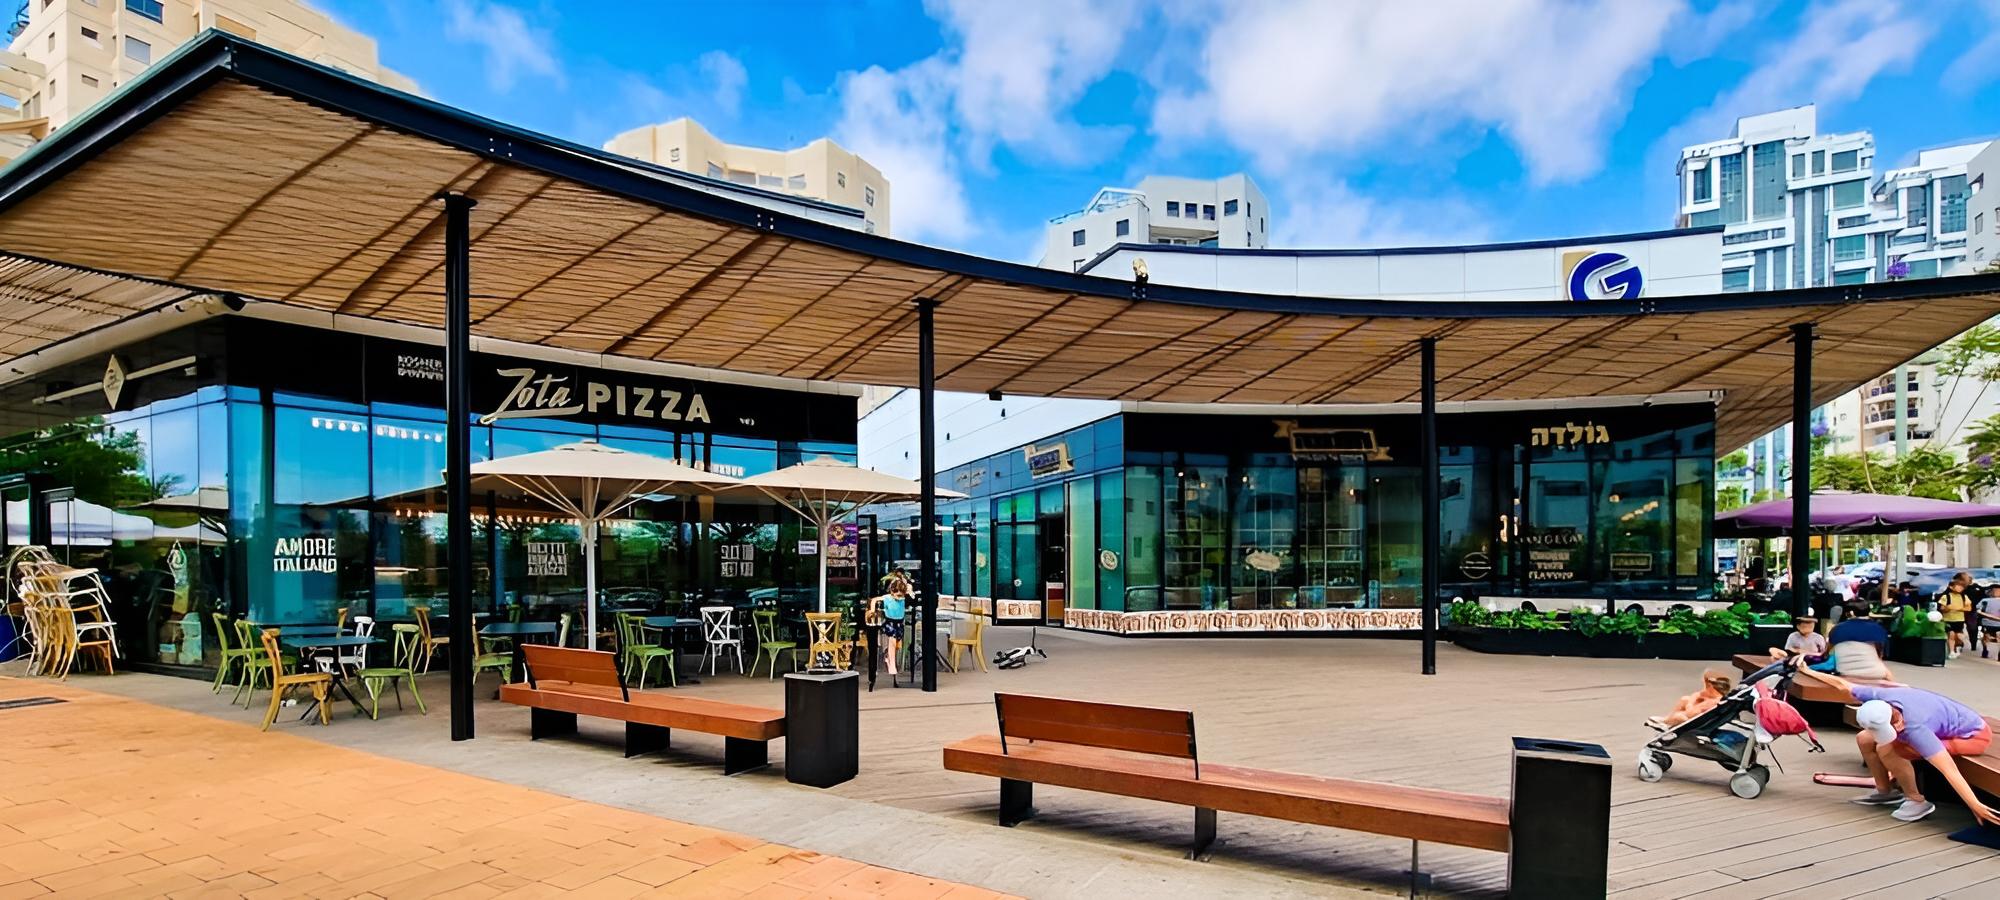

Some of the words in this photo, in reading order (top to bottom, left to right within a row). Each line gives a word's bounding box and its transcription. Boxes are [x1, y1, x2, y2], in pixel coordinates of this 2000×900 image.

[1568, 250, 1643, 300] G
[479, 368, 584, 425] Zota
[587, 382, 711, 423] PIZZA
[1531, 421, 1610, 450] גולדה
[275, 537, 336, 556] AMORE
